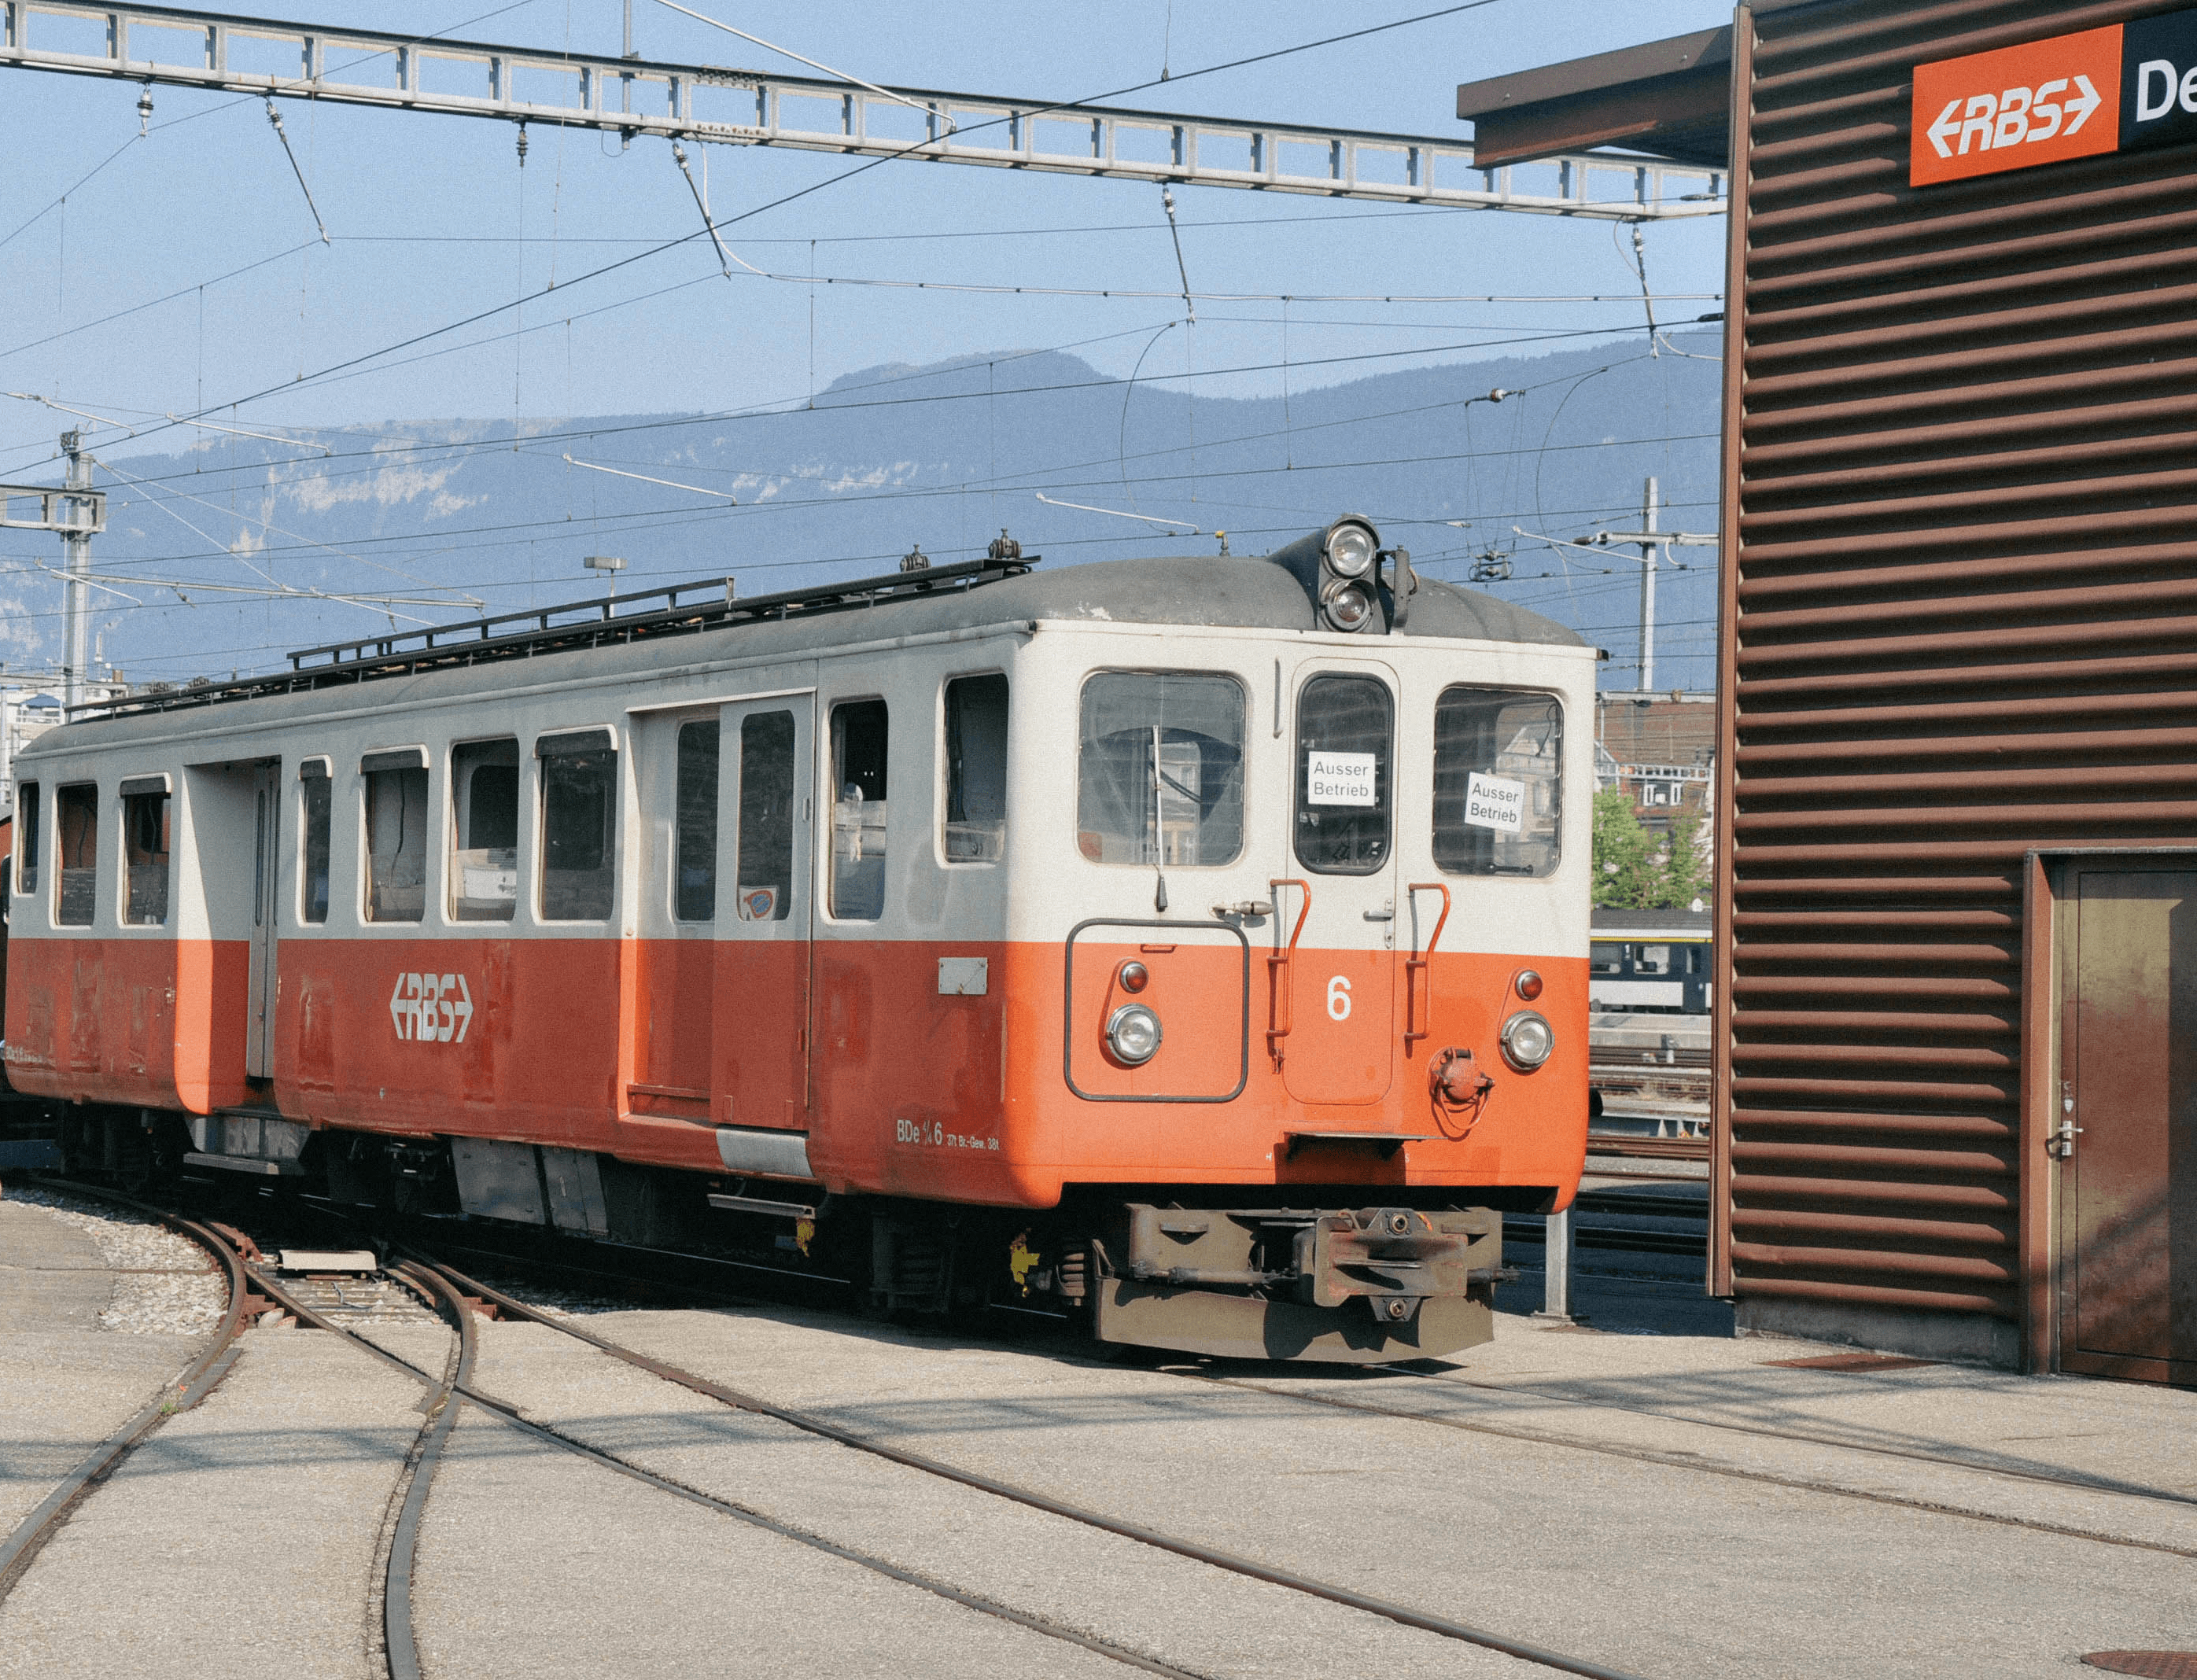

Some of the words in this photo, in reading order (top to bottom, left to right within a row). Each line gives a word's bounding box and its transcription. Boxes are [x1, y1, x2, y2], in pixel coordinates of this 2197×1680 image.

[1957, 79, 2069, 155] RBS
[1314, 761, 1369, 776] Ausser
[1314, 782, 1369, 797] Betrieb
[1472, 783, 1519, 803] Ausser
[1470, 802, 1517, 823] Betrieb
[406, 972, 455, 1042] RBS
[1328, 976, 1351, 1021] 6
[898, 1119, 920, 1144] BDe
[934, 1122, 942, 1145] 6
